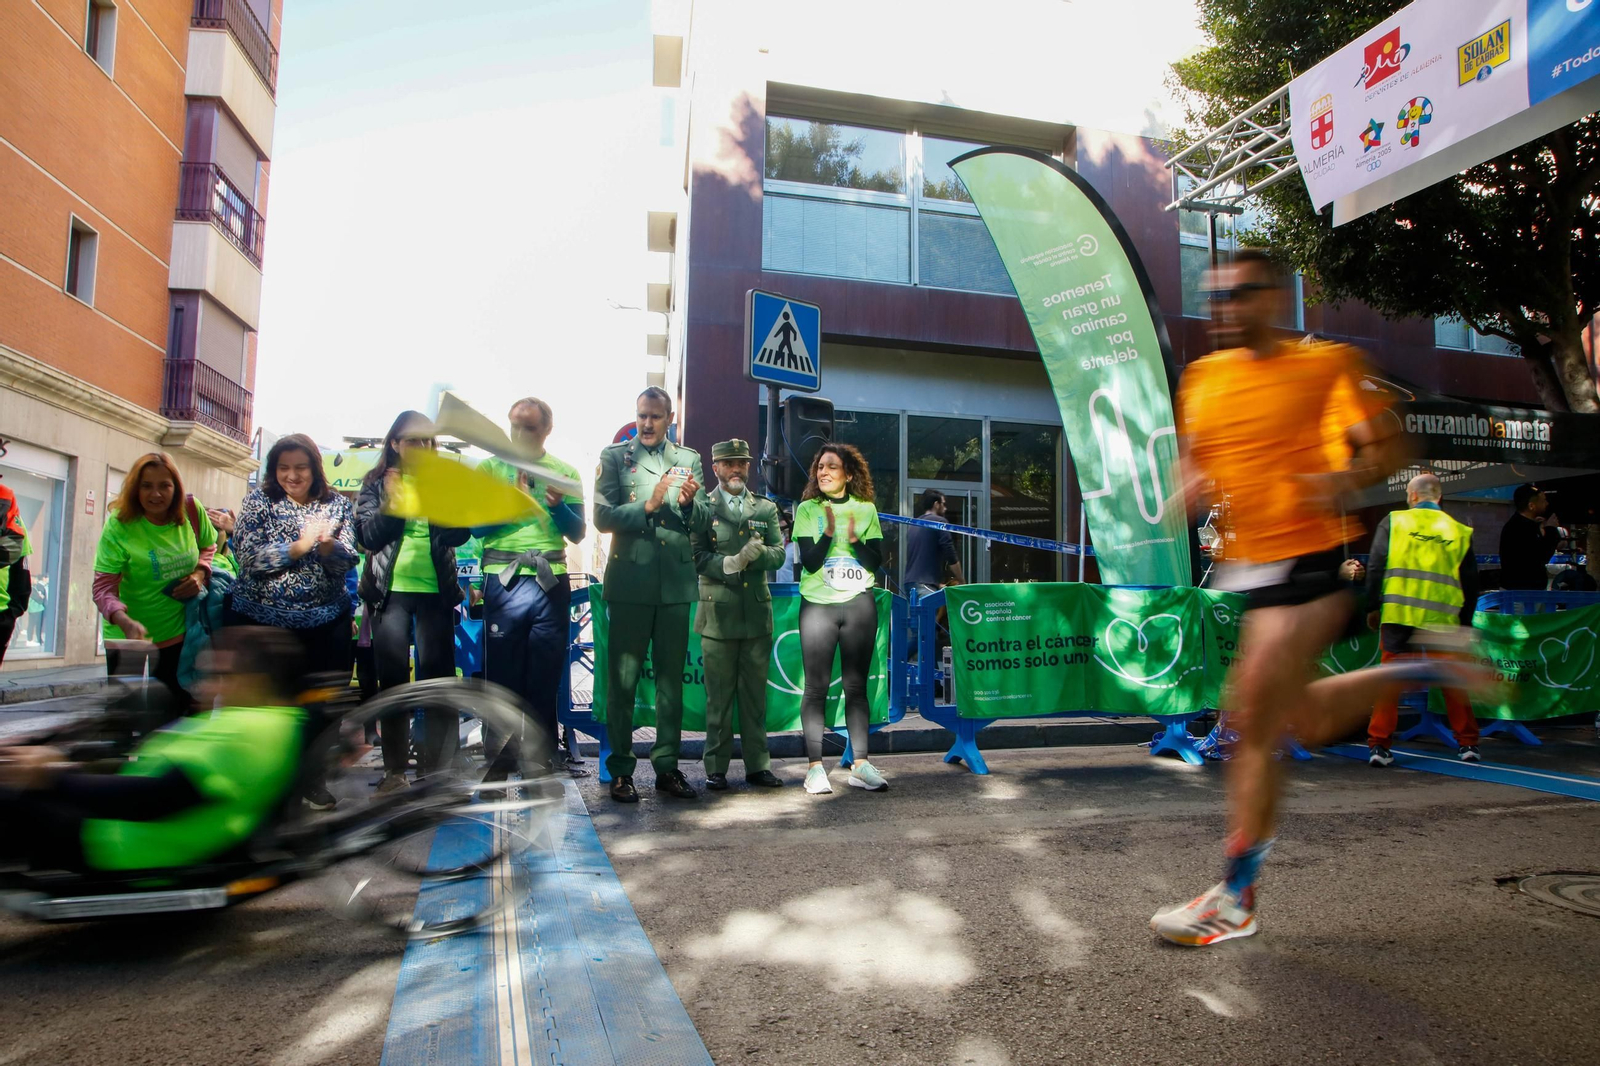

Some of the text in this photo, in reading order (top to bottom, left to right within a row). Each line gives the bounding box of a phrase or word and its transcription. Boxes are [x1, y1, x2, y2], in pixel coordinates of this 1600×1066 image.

[1465, 44, 1505, 74] DE CABRAS
[1304, 145, 1345, 174] ALMERÍA
[1377, 146, 1392, 159] 2005
[1313, 163, 1336, 180] CIUDAD
[985, 608, 1012, 616] española
[966, 638, 1022, 653] Contra
[1026, 635, 1042, 650] el
[966, 658, 1020, 671] somos
[1025, 652, 1059, 668] solo
